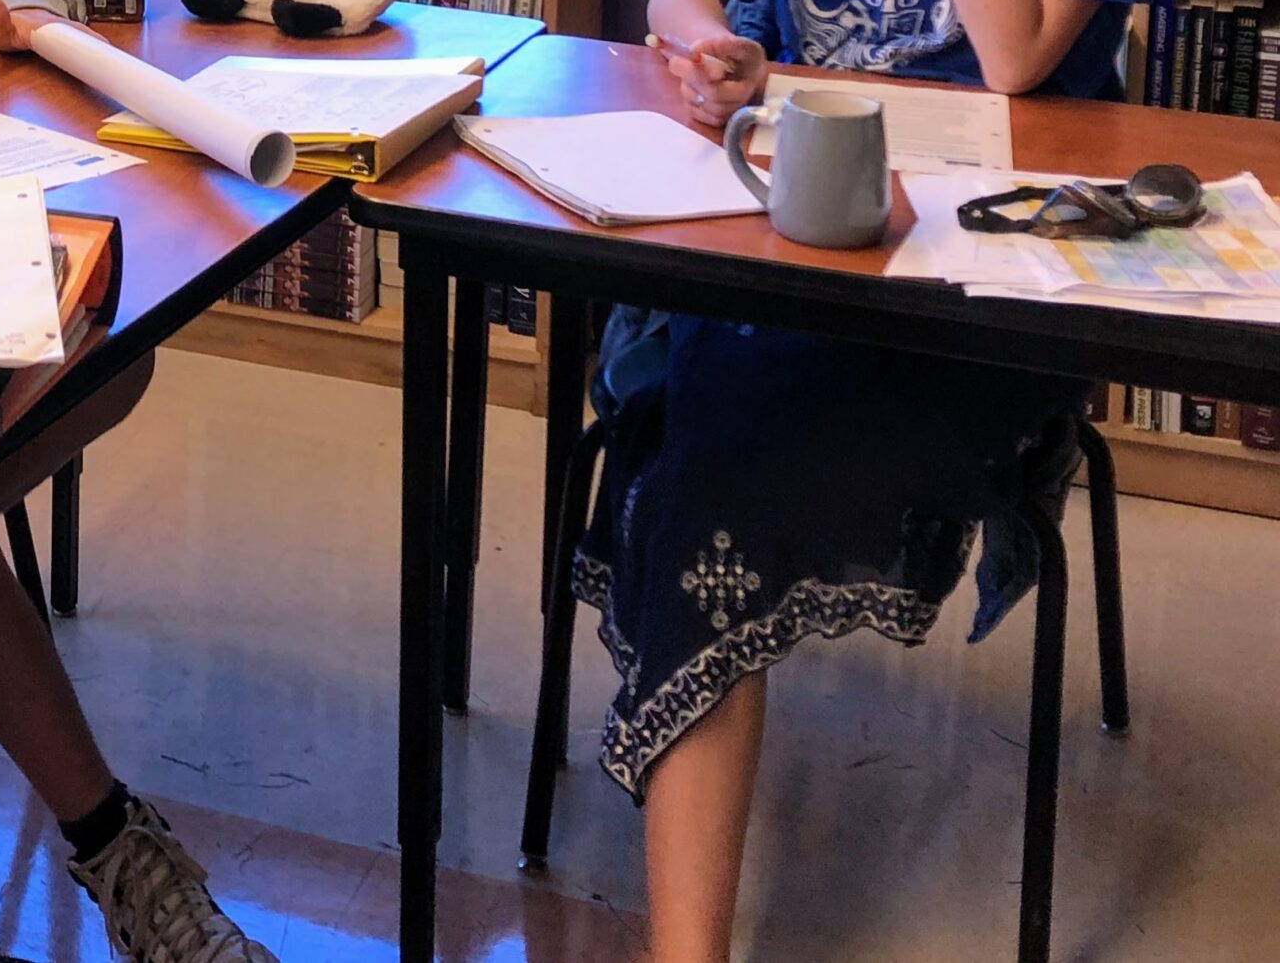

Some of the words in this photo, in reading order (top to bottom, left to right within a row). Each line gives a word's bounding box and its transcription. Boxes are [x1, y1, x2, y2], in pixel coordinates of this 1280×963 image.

[1156, 6, 1167, 53] ADVERTISING
[1235, 30, 1255, 70] FABLES
[1234, 71, 1251, 84] OF
[1261, 65, 1277, 87] LAND
[1261, 89, 1276, 100] OF
[1260, 103, 1276, 118] DES
[1135, 397, 1147, 429] PRESS
